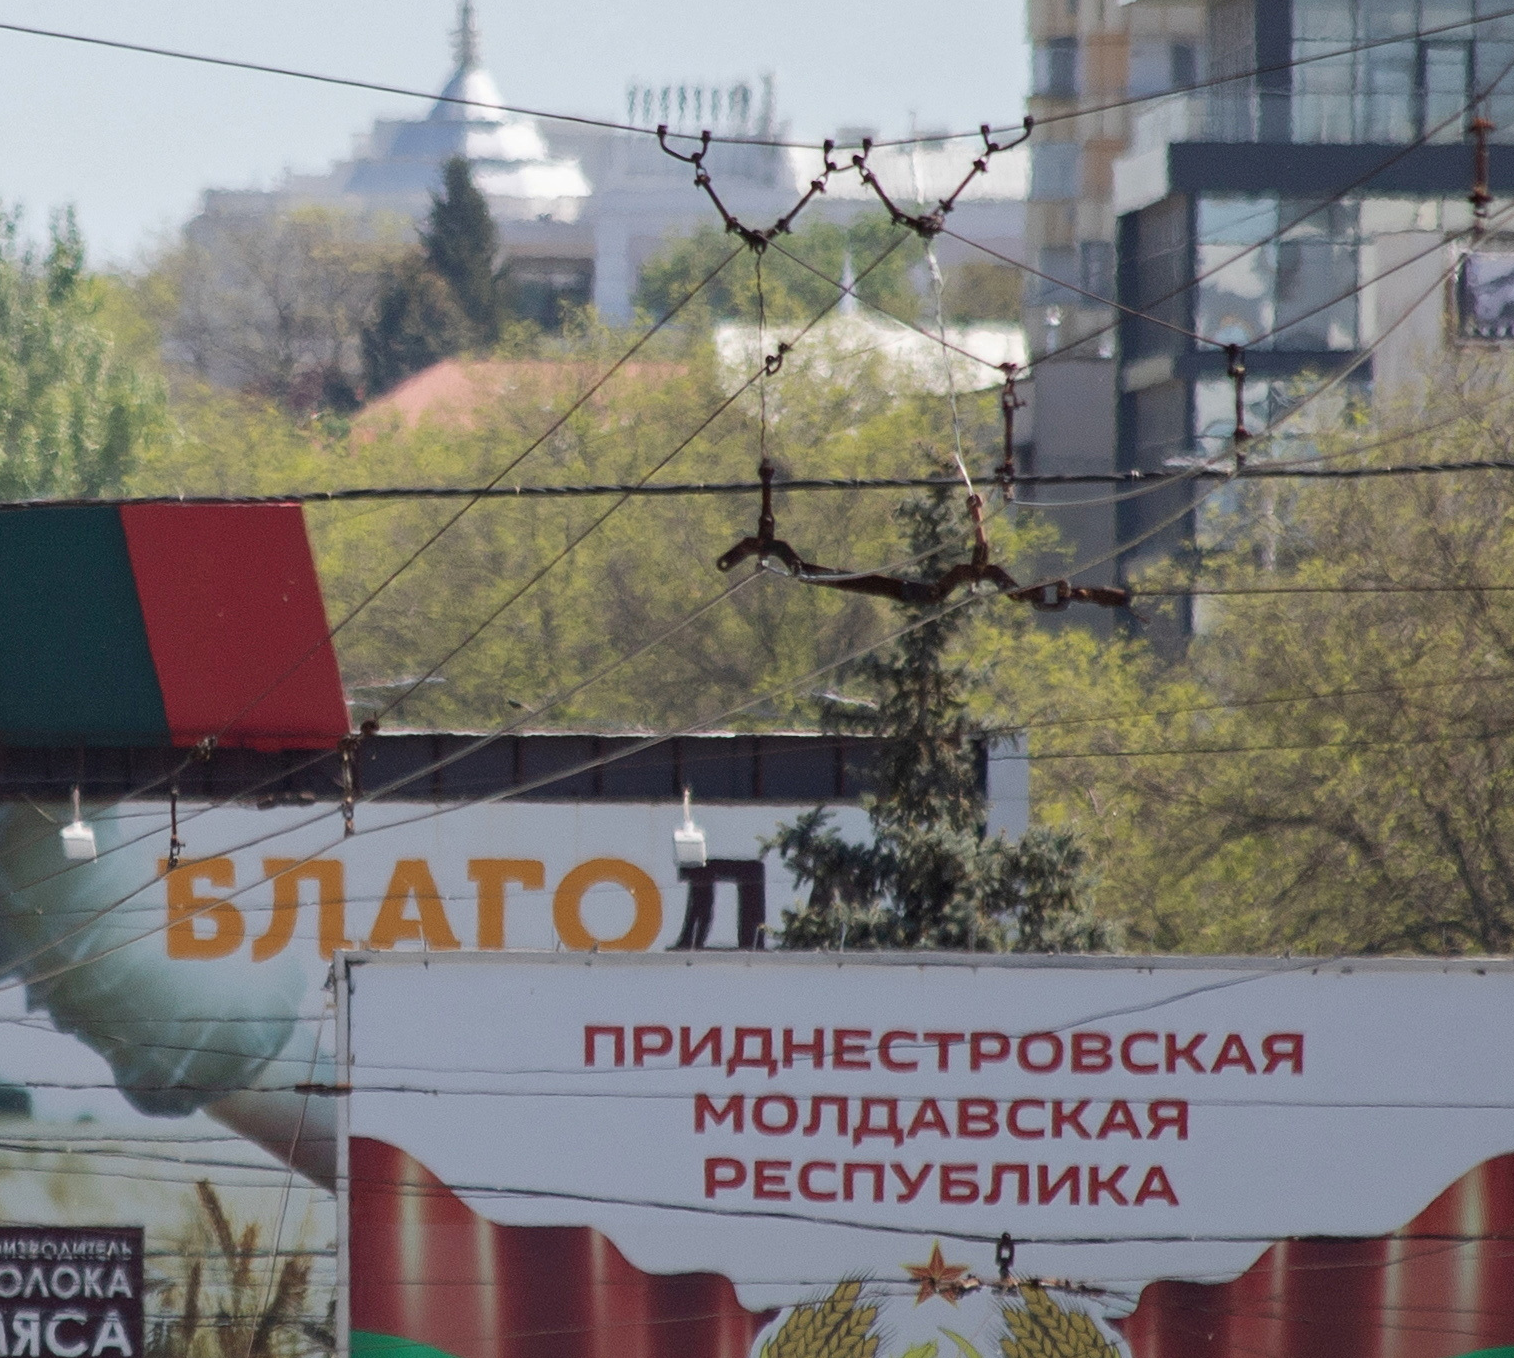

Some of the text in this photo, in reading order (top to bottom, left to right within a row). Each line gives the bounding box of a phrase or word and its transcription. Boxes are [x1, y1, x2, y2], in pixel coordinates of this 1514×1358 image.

[583, 1025, 1305, 1077] ПРИДНЕСТРОВСКАЯ
[693, 1093, 1190, 1148] МОЛДАВСКАЯ
[703, 1156, 1180, 1208] РЕСПУБЛИКА
